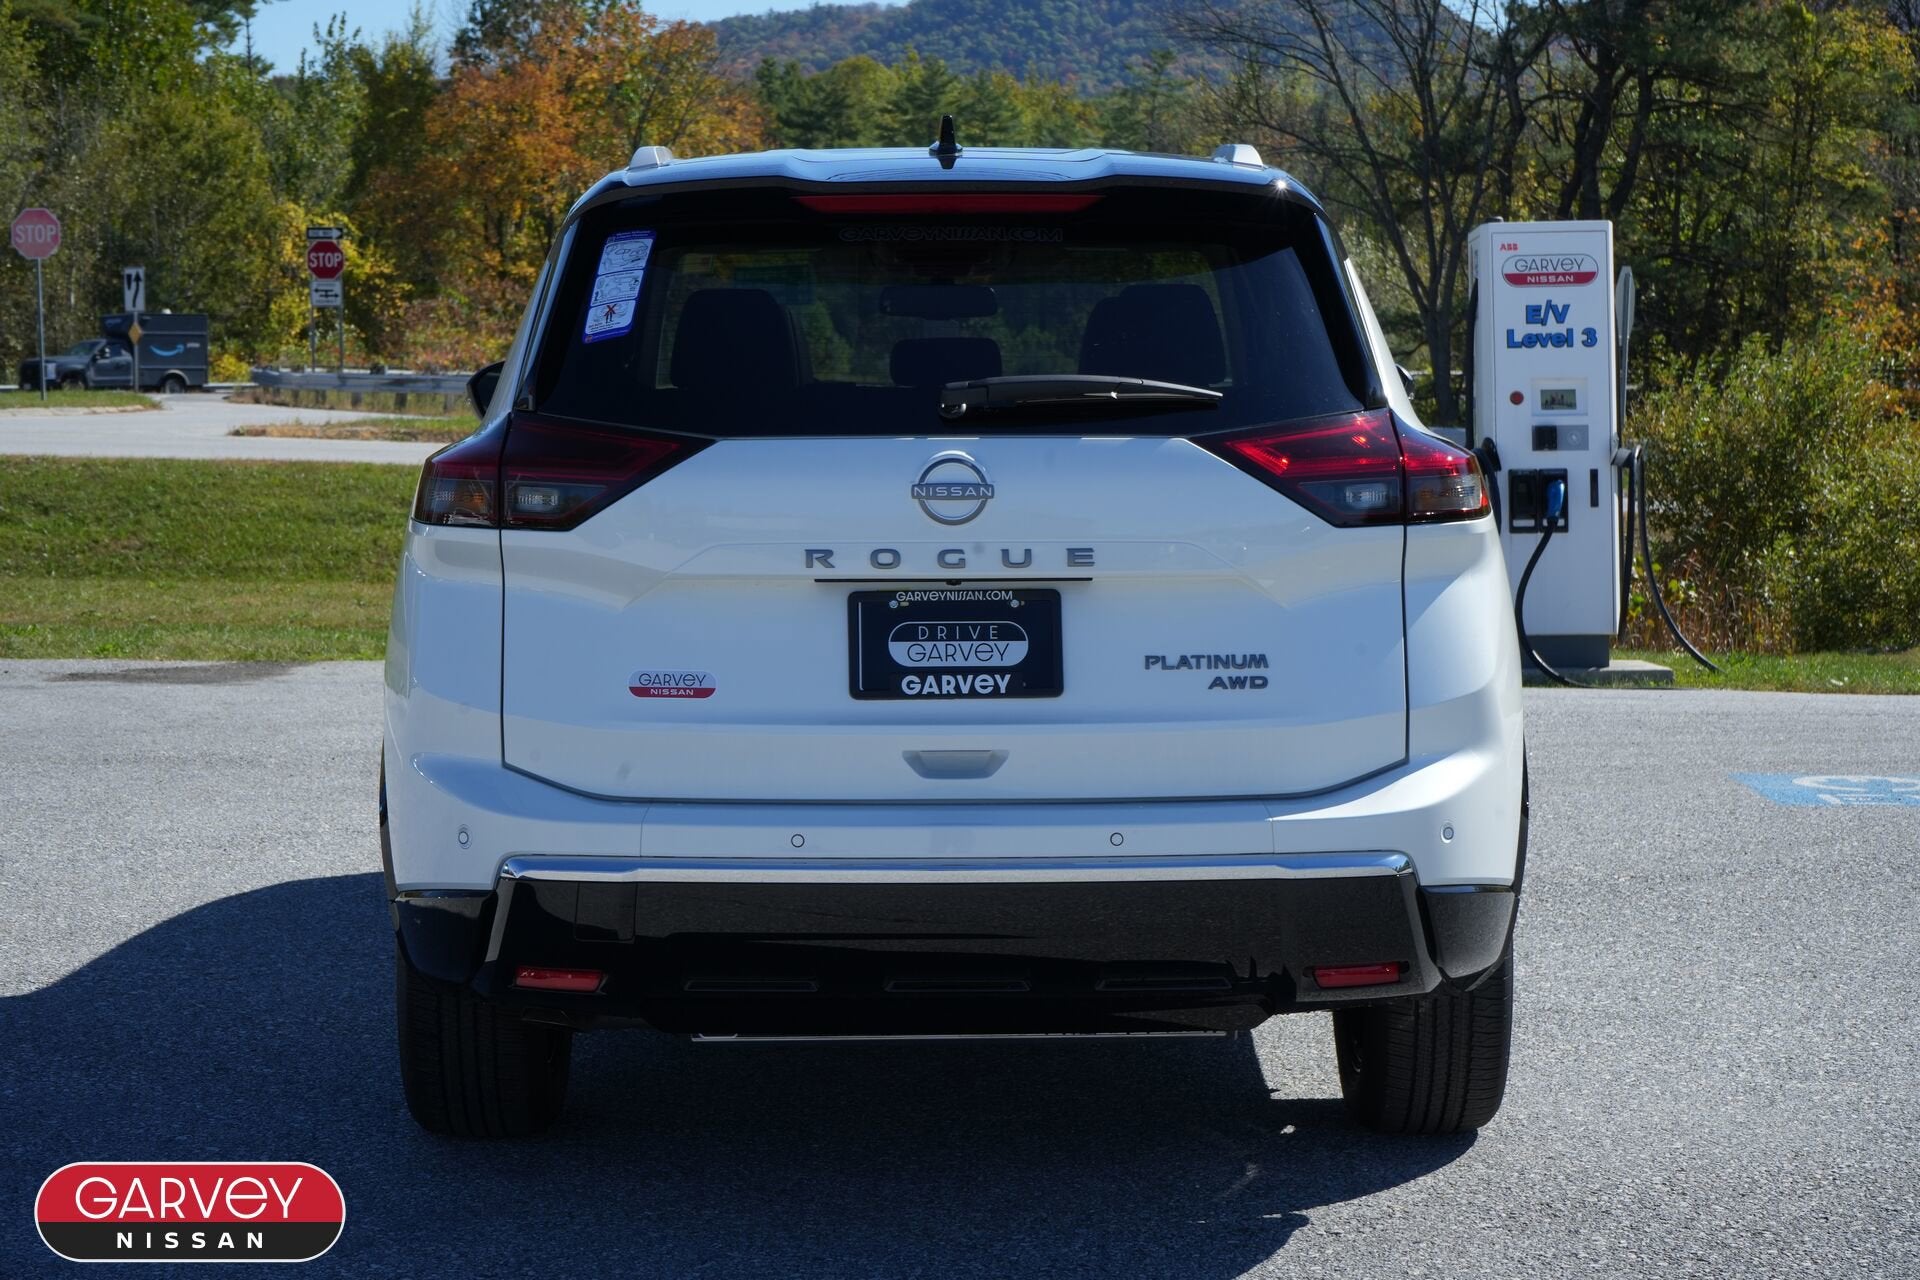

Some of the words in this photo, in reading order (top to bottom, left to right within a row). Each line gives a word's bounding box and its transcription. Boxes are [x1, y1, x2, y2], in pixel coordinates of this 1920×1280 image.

[15, 224, 57, 243] STOP
[1500, 243, 1519, 251] ABB
[309, 252, 342, 268] STOP
[1514, 257, 1585, 273] GARVEY
[1526, 275, 1574, 283] NISSAN
[1525, 299, 1571, 326] E/V
[1506, 328, 1574, 349] Level
[1581, 327, 1598, 348] 3
[913, 486, 993, 497] NISSAN
[804, 548, 1096, 570] ROGUE
[896, 590, 1013, 602] GARVEYNISSAN.COM
[918, 625, 999, 640] DRIVE
[907, 642, 1010, 663] GARVEY
[1144, 654, 1269, 671] PLATINUM
[638, 673, 707, 687] GARVEY
[901, 674, 1011, 696] GARVEY
[1207, 676, 1269, 690] AWD
[650, 688, 694, 696] NISSAN
